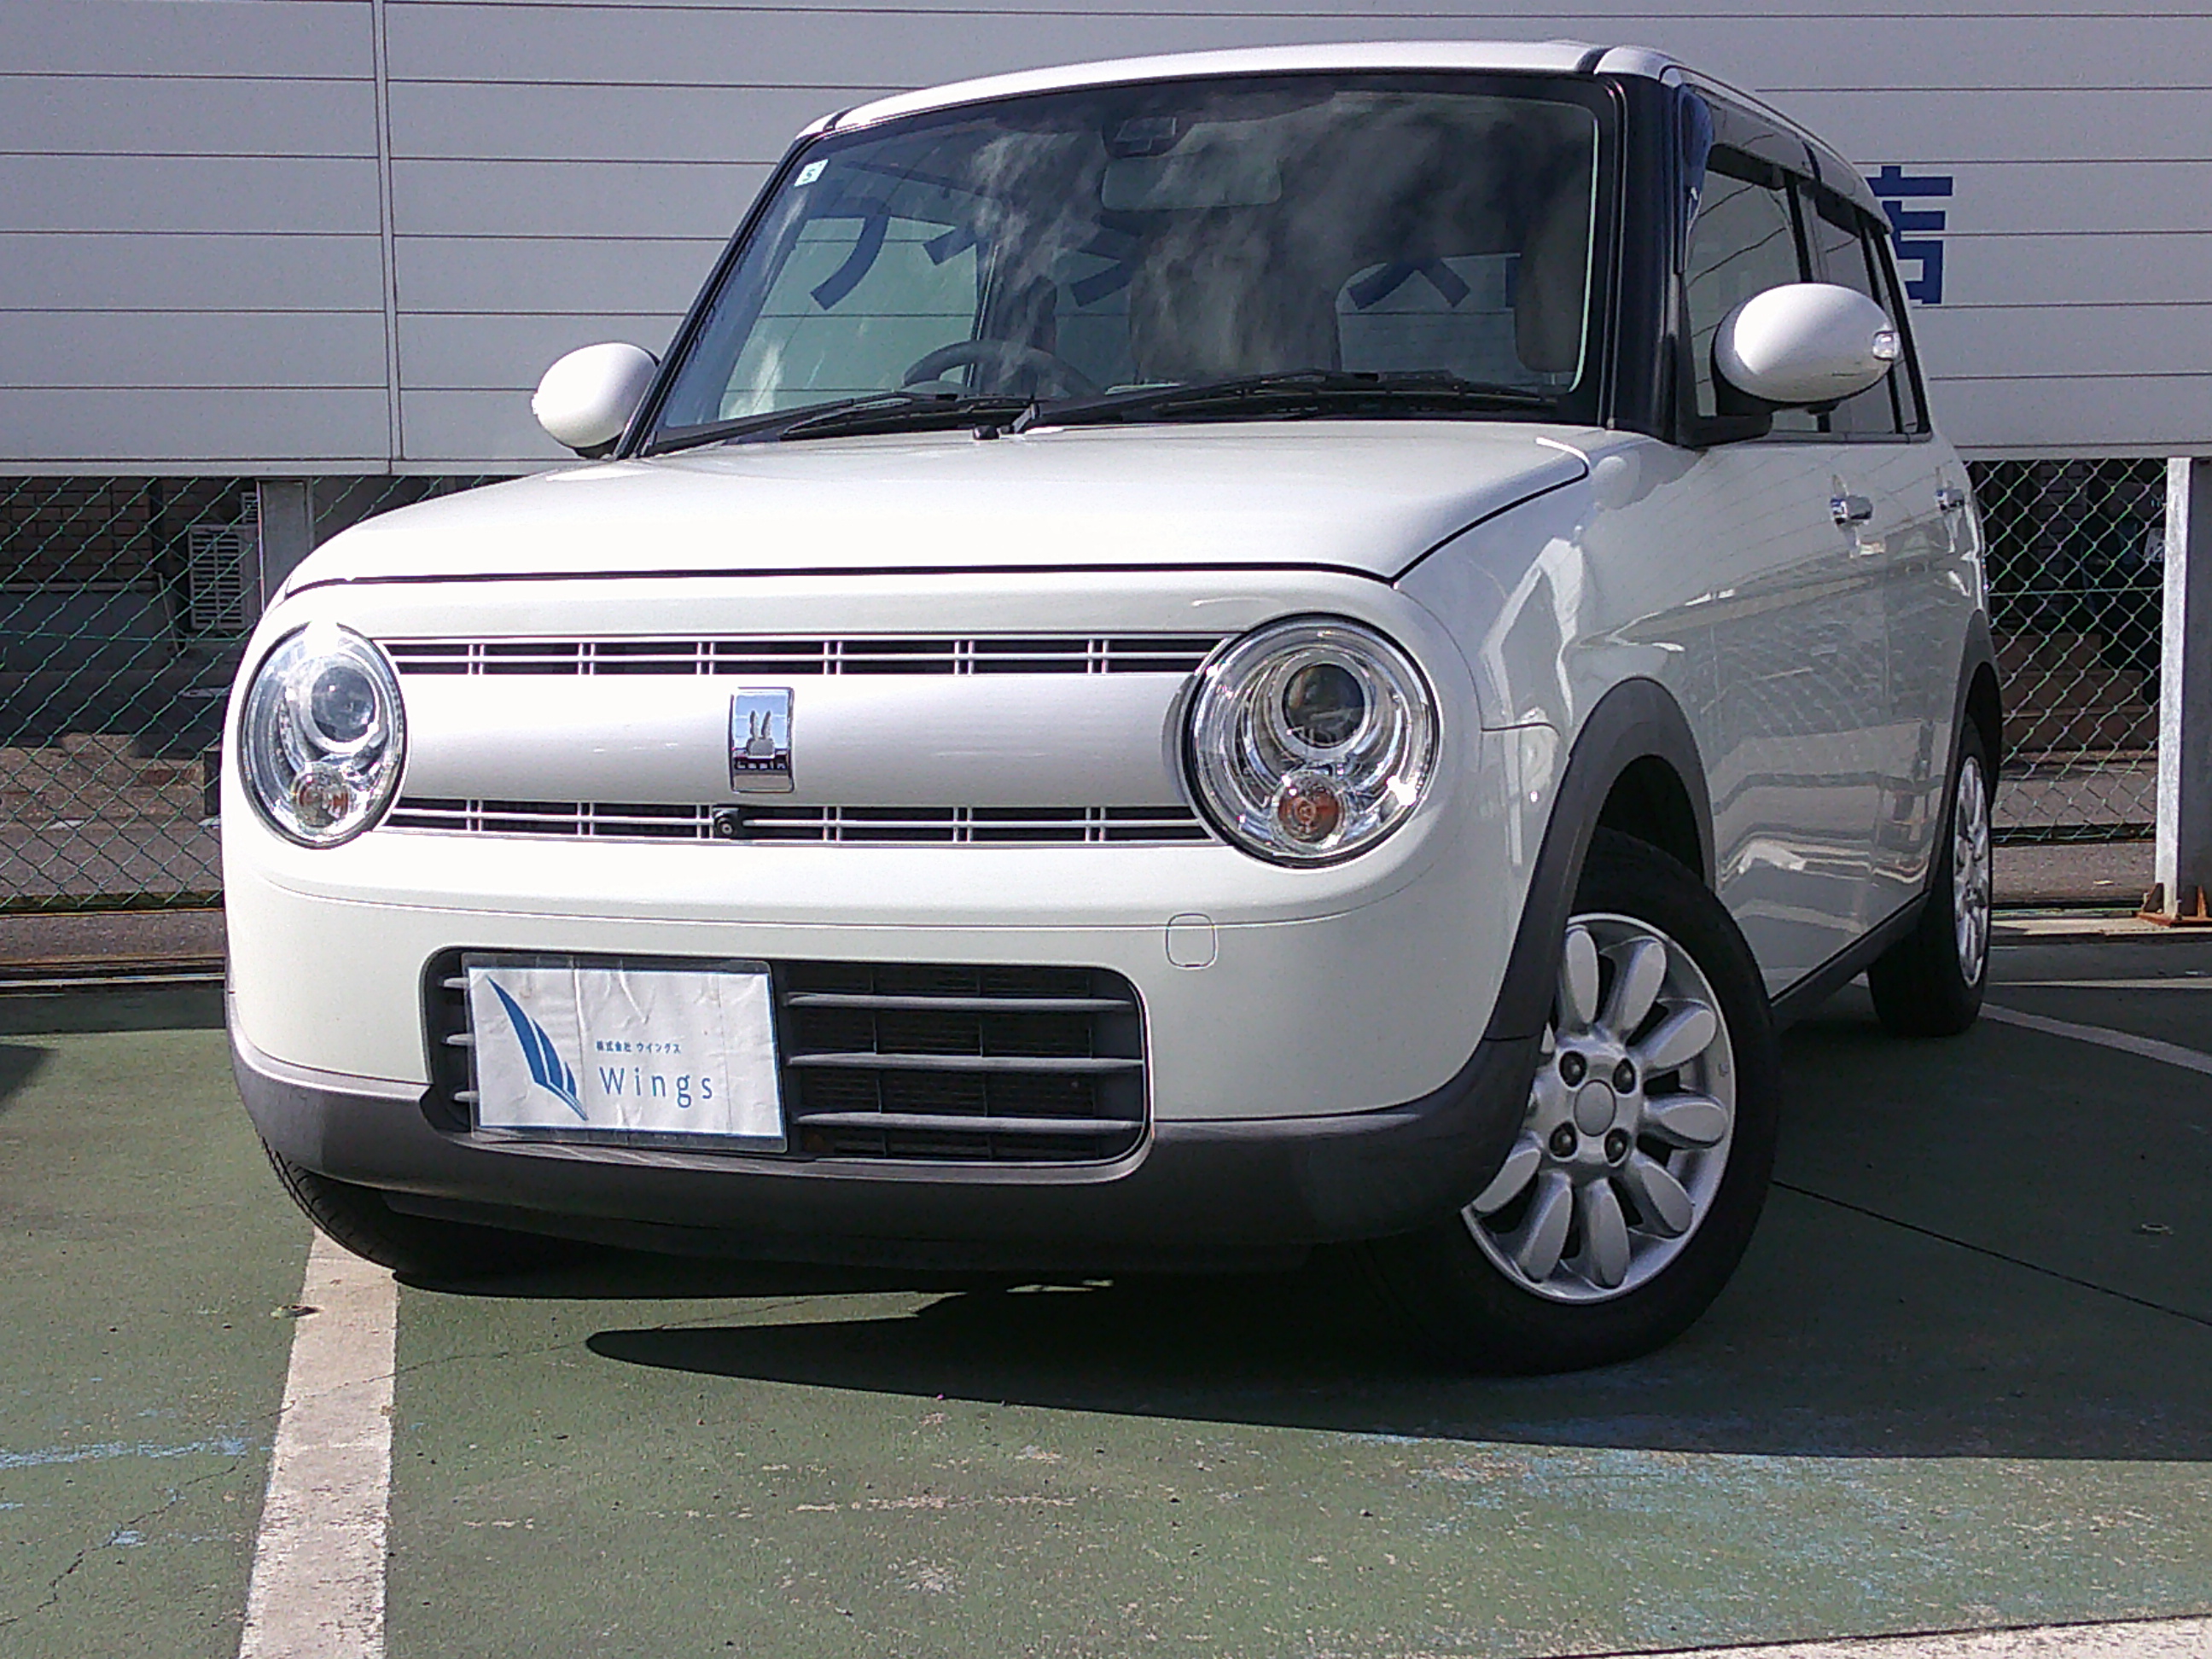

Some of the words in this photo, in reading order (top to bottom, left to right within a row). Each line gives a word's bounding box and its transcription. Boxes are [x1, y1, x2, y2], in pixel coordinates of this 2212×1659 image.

[596, 1040, 632, 1052] 株式会社
[599, 1066, 713, 1109] Wings
